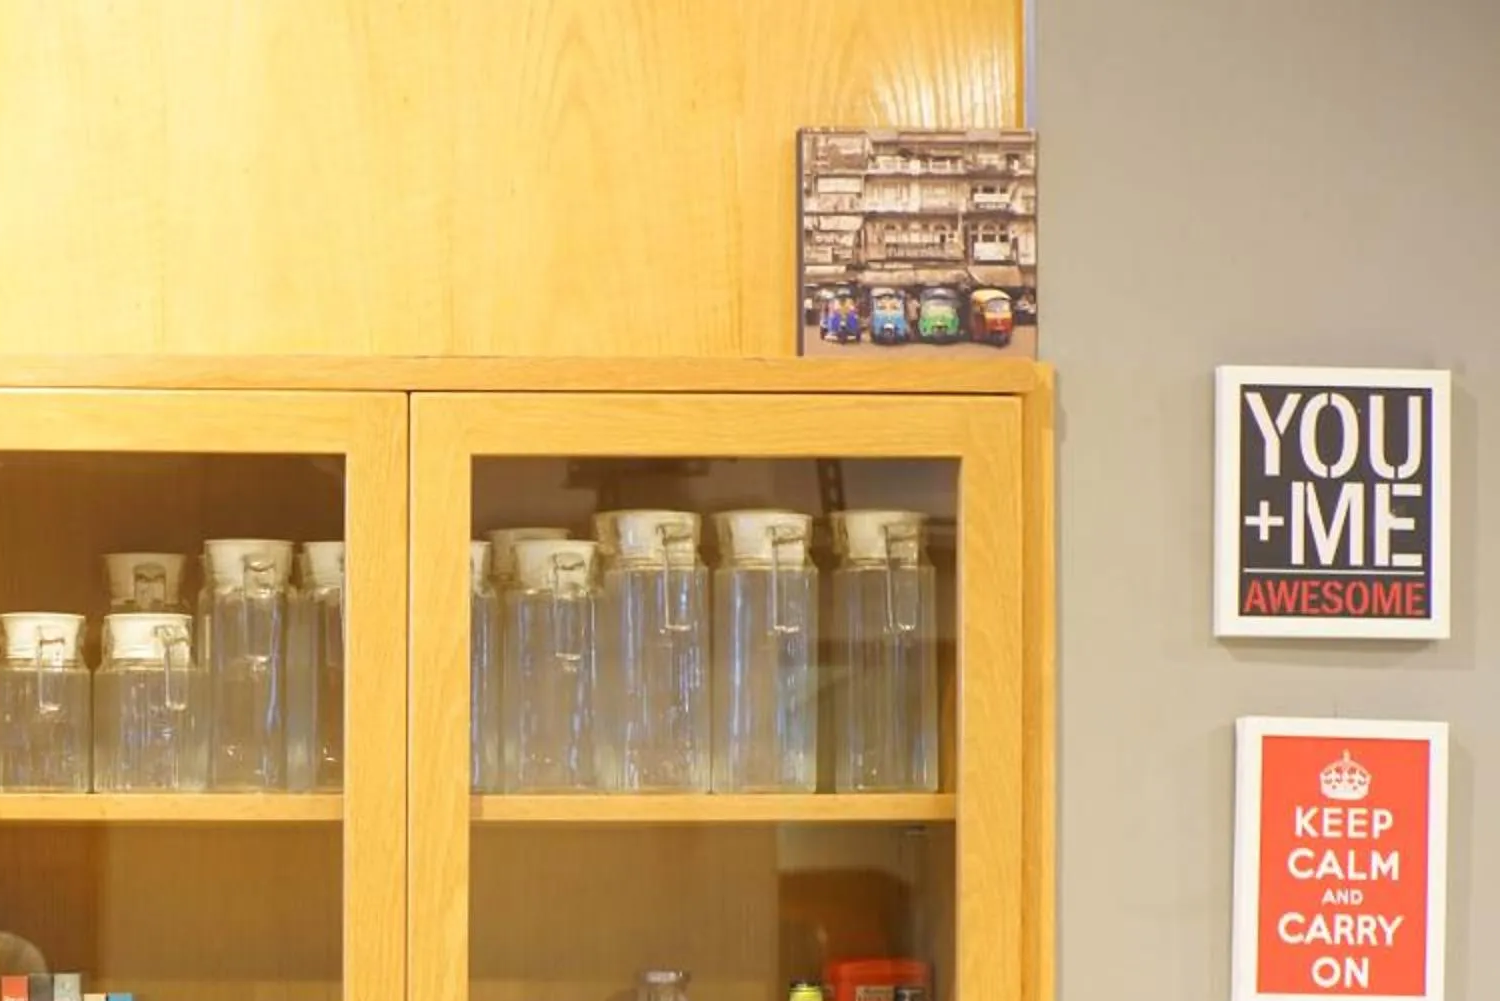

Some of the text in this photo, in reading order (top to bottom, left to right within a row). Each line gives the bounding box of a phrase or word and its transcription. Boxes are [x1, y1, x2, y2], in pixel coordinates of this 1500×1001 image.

[1244, 392, 1423, 479] YOU
[1243, 579, 1425, 616] AWESOME
[1294, 806, 1394, 839] KEEP
[1287, 848, 1400, 881] CALM
[1321, 888, 1364, 905] AND
[1277, 912, 1404, 947] CARRY
[1311, 956, 1370, 989] ON
